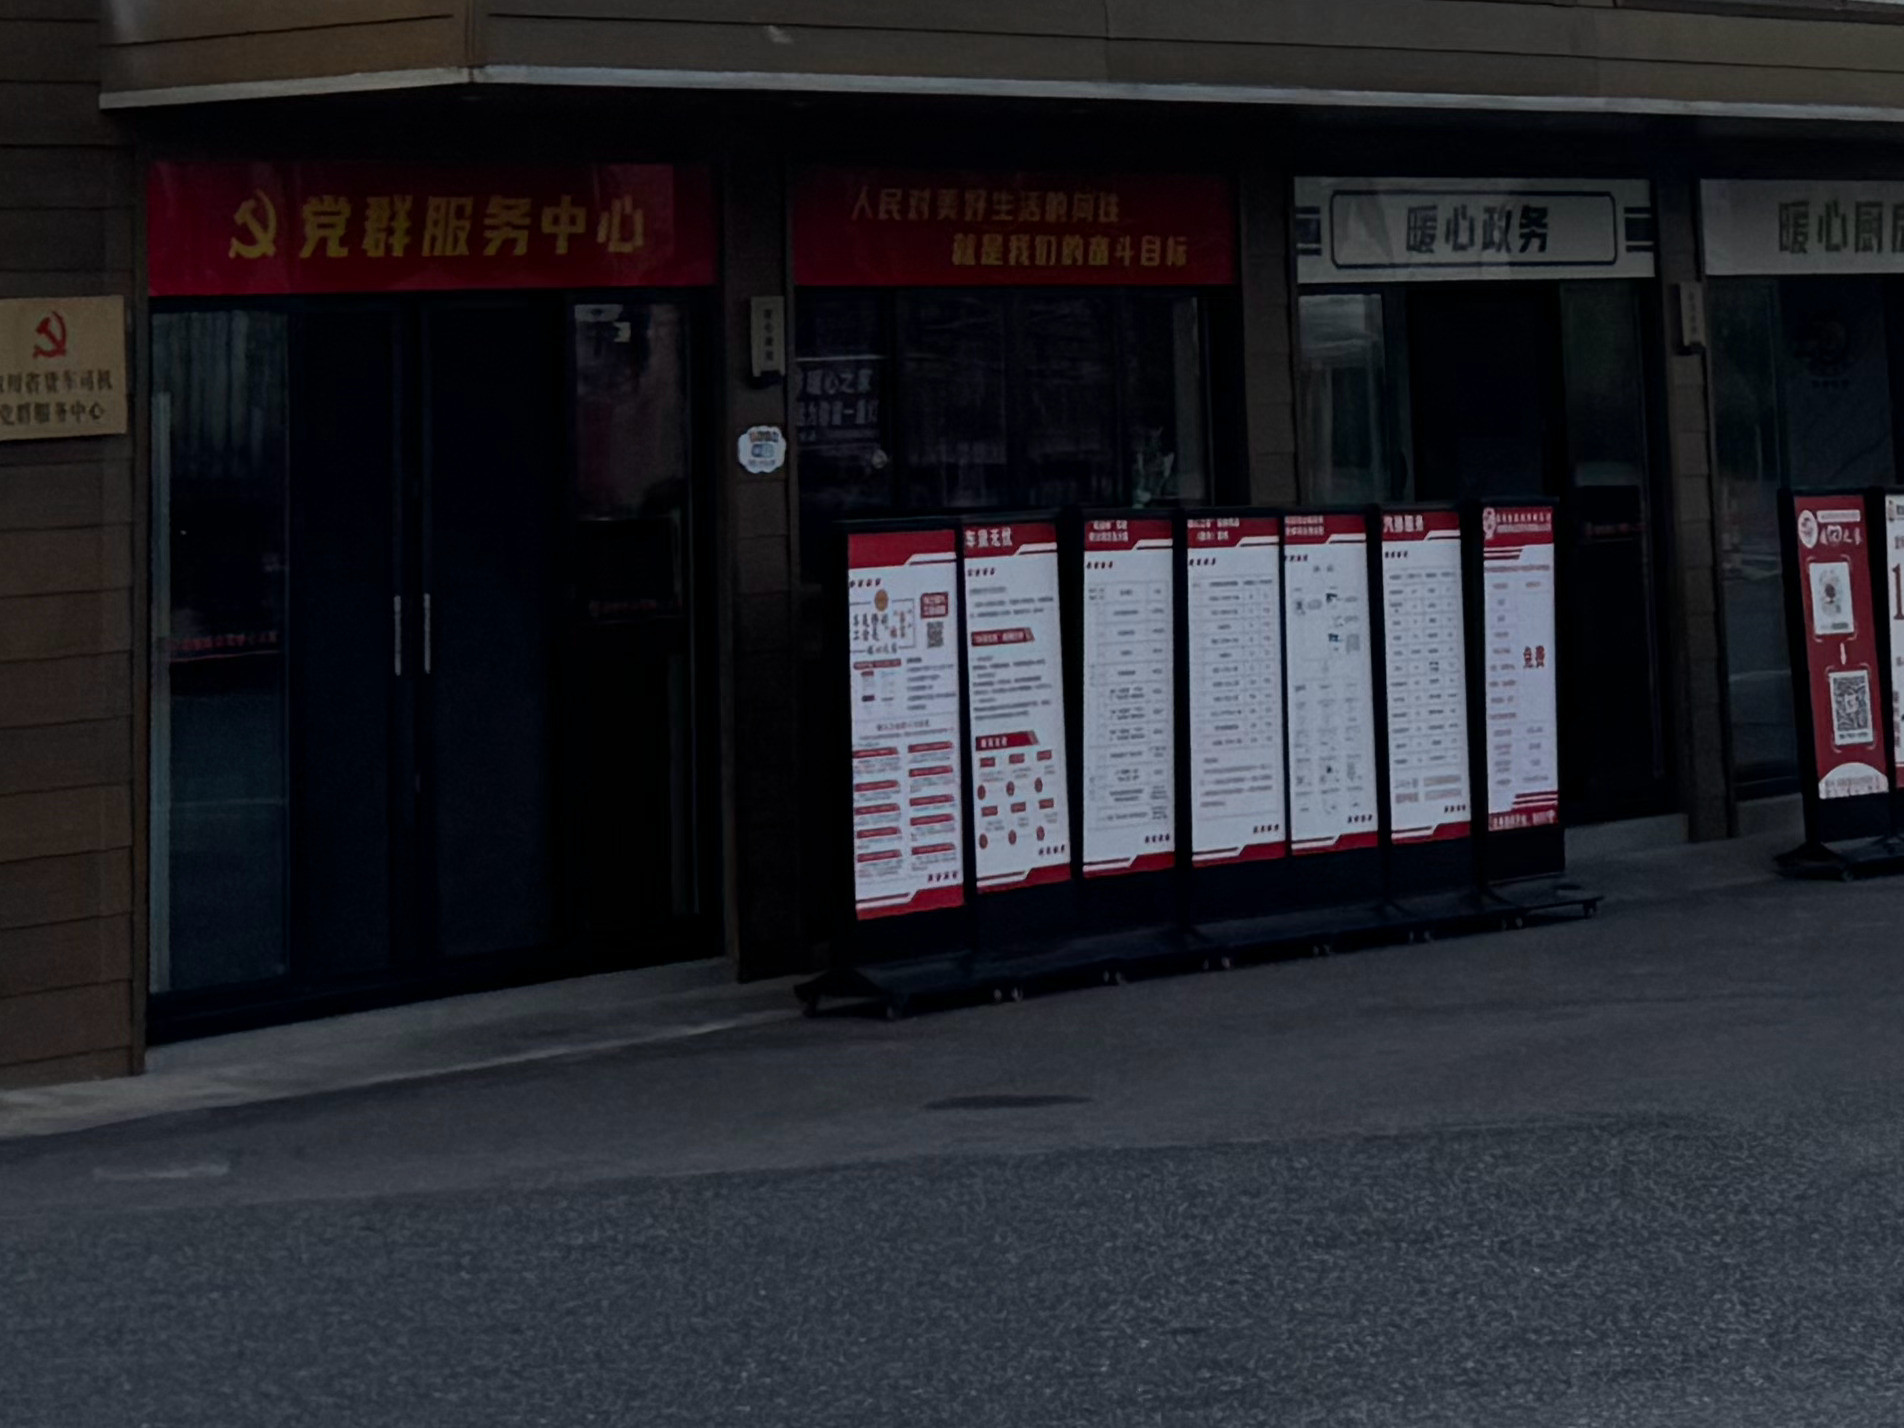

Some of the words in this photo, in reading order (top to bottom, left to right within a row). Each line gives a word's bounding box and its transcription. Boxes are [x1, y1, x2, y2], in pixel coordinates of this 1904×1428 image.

[298, 194, 646, 259] 党群服务中心
[850, 185, 1120, 223] 人民对美好生活的向往
[951, 232, 1188, 267] 就是我们的奋斗目标
[1405, 202, 1550, 255] 暖心政务
